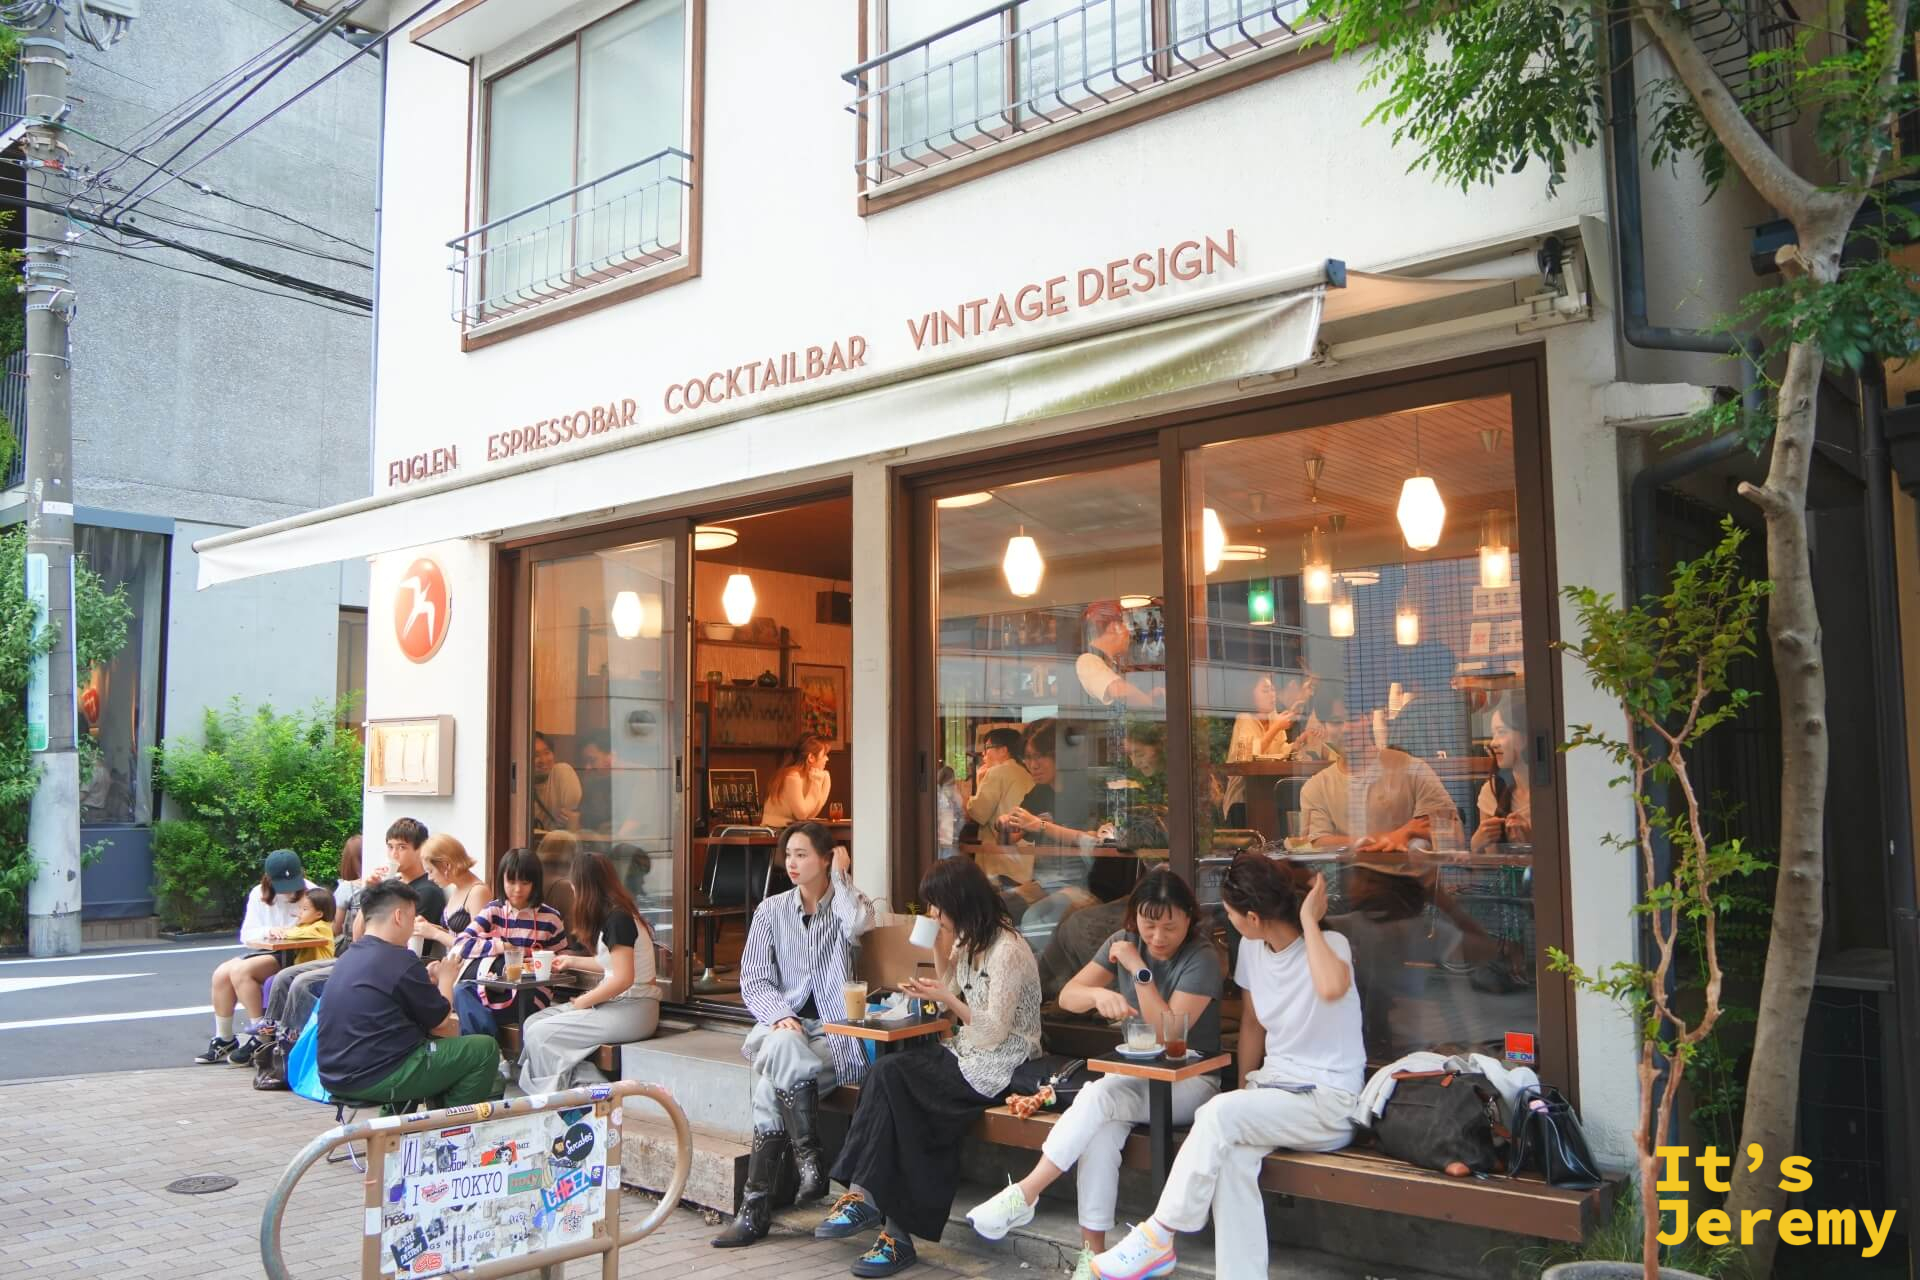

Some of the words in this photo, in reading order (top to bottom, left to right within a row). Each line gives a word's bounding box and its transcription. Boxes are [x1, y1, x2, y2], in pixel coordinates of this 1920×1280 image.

[388, 445, 457, 487] FUGLEN
[487, 399, 637, 461] ESPRESSOBAR
[664, 335, 867, 415] COCKTAILBAR
[907, 275, 1070, 351] VINTAGE
[1077, 229, 1236, 309] DESIGN
[451, 1171, 502, 1200] TOKYO
